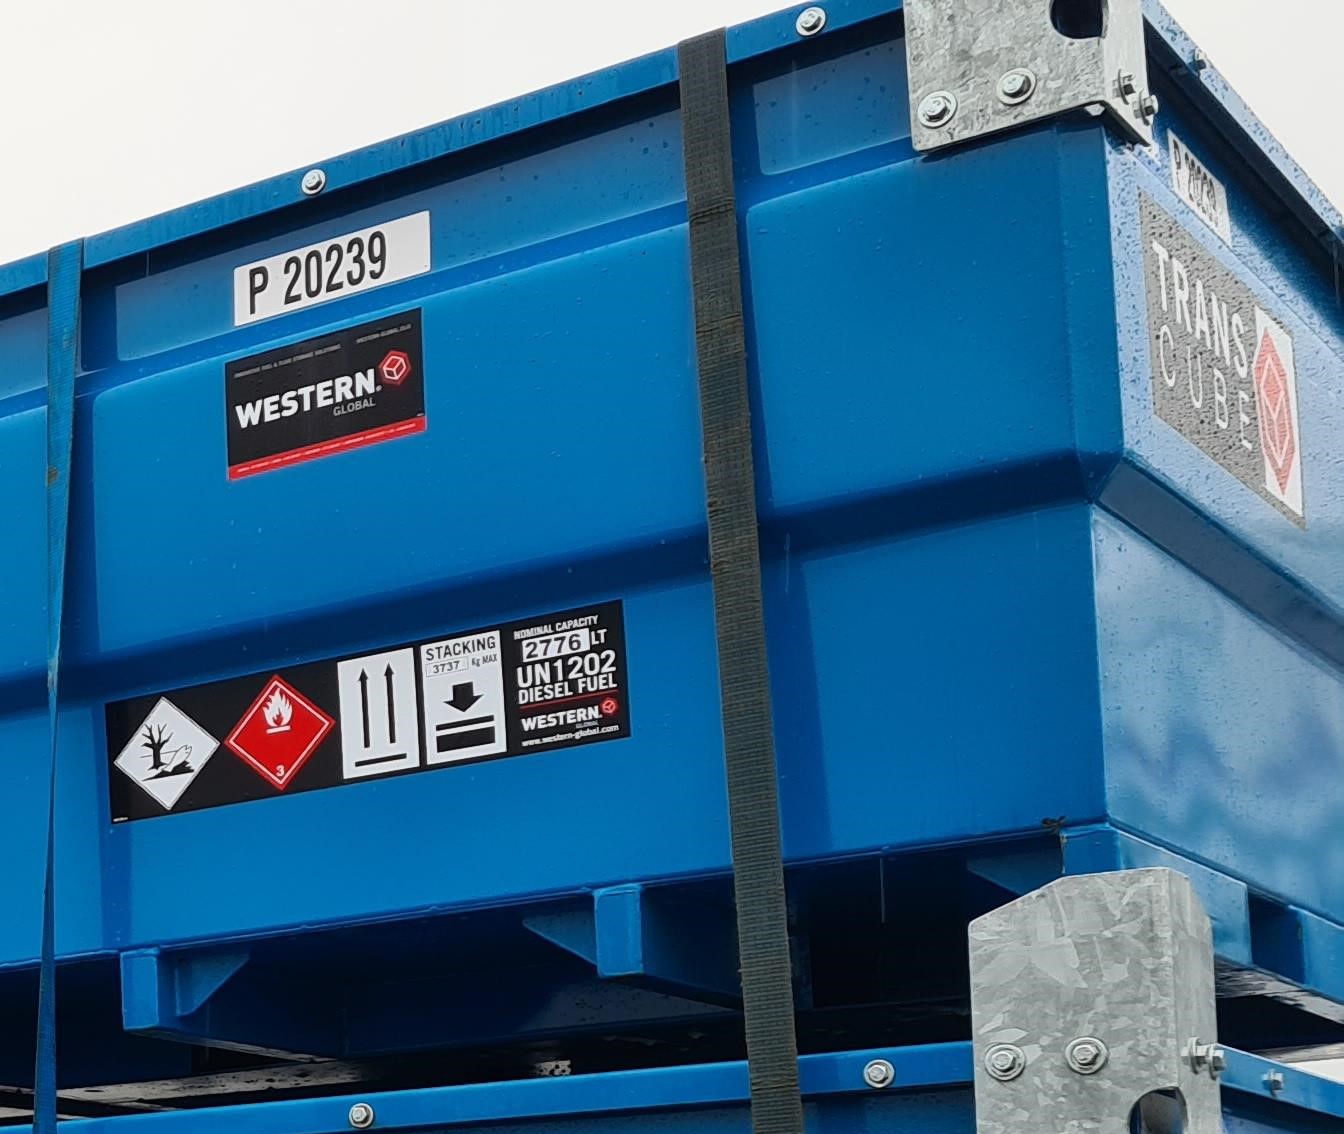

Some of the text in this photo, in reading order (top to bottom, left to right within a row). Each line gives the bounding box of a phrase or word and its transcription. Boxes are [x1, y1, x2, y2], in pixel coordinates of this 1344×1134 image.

[249, 230, 387, 315] P 20239
[1152, 239, 1248, 379] TRANS
[235, 368, 377, 429] WESTERN
[1160, 325, 1253, 450] CUBE
[333, 397, 376, 416] GLOBAL
[513, 615, 599, 640] NOMINAL CAPACITY
[426, 636, 496, 661] STACKING
[525, 629, 607, 659] 2776 LT
[432, 660, 460, 674] 3737
[482, 653, 498, 665] MAX
[516, 650, 617, 688] UN1202
[518, 672, 618, 705] DIESEL FUEL
[521, 706, 601, 732] WESTERN
[275, 765, 285, 777] 3
